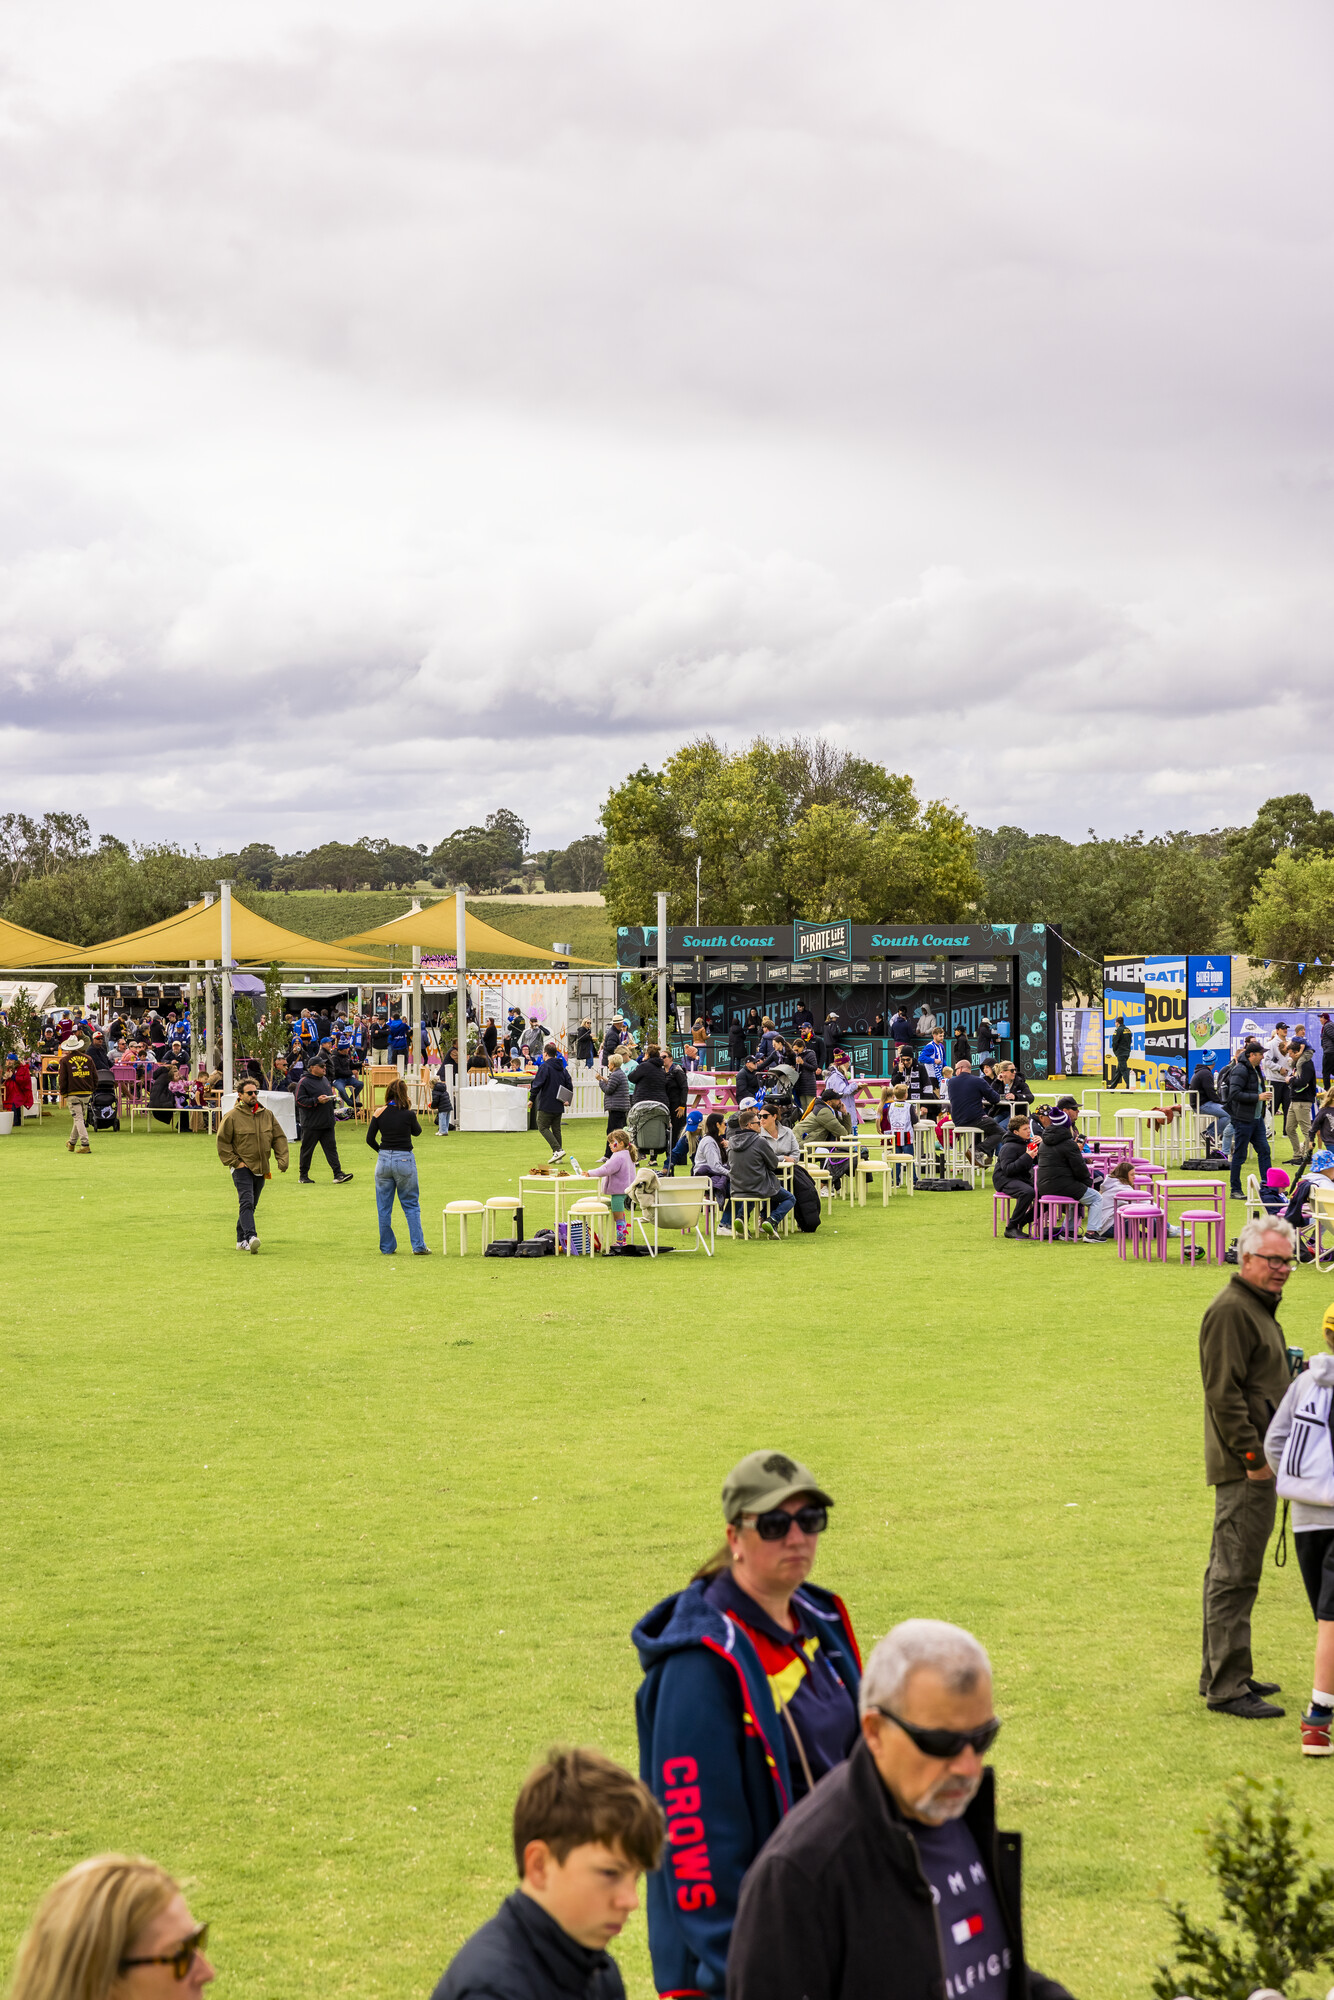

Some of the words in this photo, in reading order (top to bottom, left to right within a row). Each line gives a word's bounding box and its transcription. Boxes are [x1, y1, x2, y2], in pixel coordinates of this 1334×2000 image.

[682, 935, 728, 947] South
[730, 934, 776, 947] Coast
[870, 934, 920, 947] South
[922, 933, 971, 946] Coast
[663, 1755, 717, 1912] CROWS
